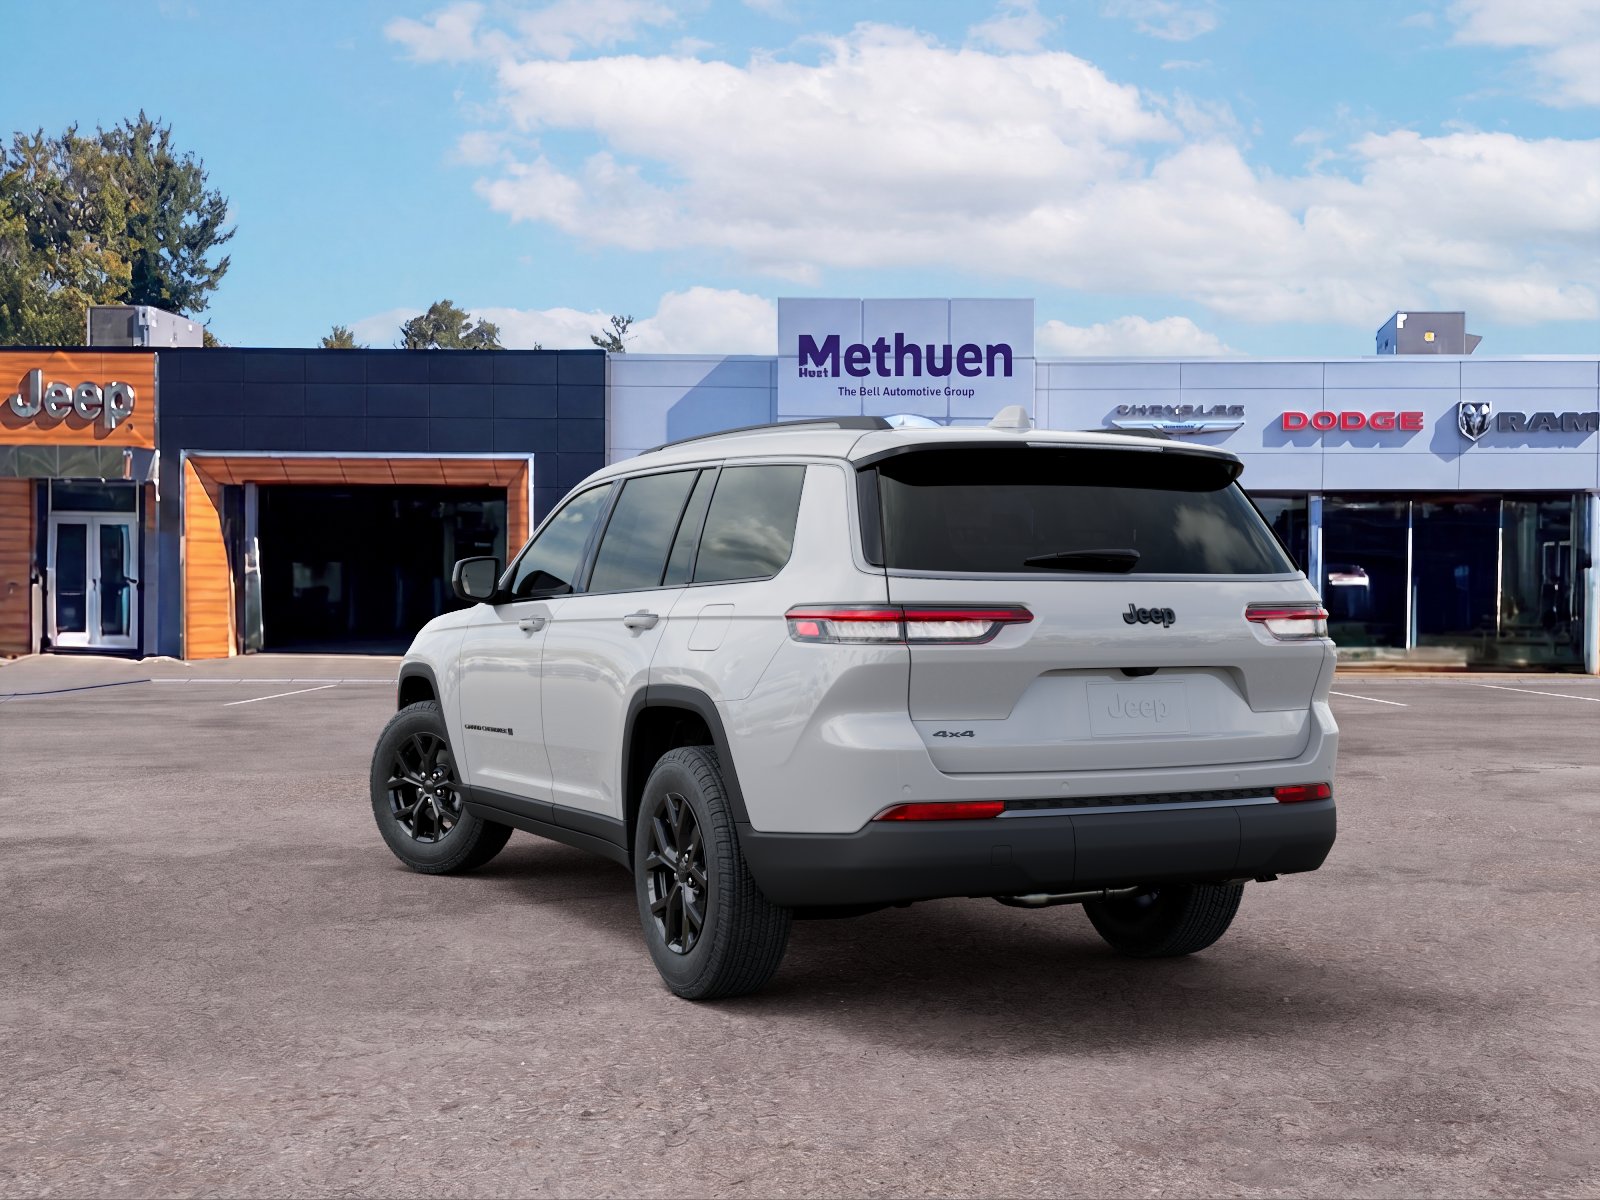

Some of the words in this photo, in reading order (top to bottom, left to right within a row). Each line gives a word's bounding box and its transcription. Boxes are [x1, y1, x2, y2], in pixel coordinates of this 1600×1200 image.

[798, 332, 1013, 377] Methuen
[9, 368, 136, 430] Jeep
[838, 387, 857, 397] The
[859, 387, 880, 397] Bell
[883, 387, 942, 397] Automotive
[944, 387, 975, 398] Group
[1282, 411, 1424, 431] DODGE
[1498, 411, 1599, 432] RAM
[1122, 603, 1176, 628] Jeep
[1107, 693, 1170, 723] Jeep
[932, 730, 976, 738] 4x4
